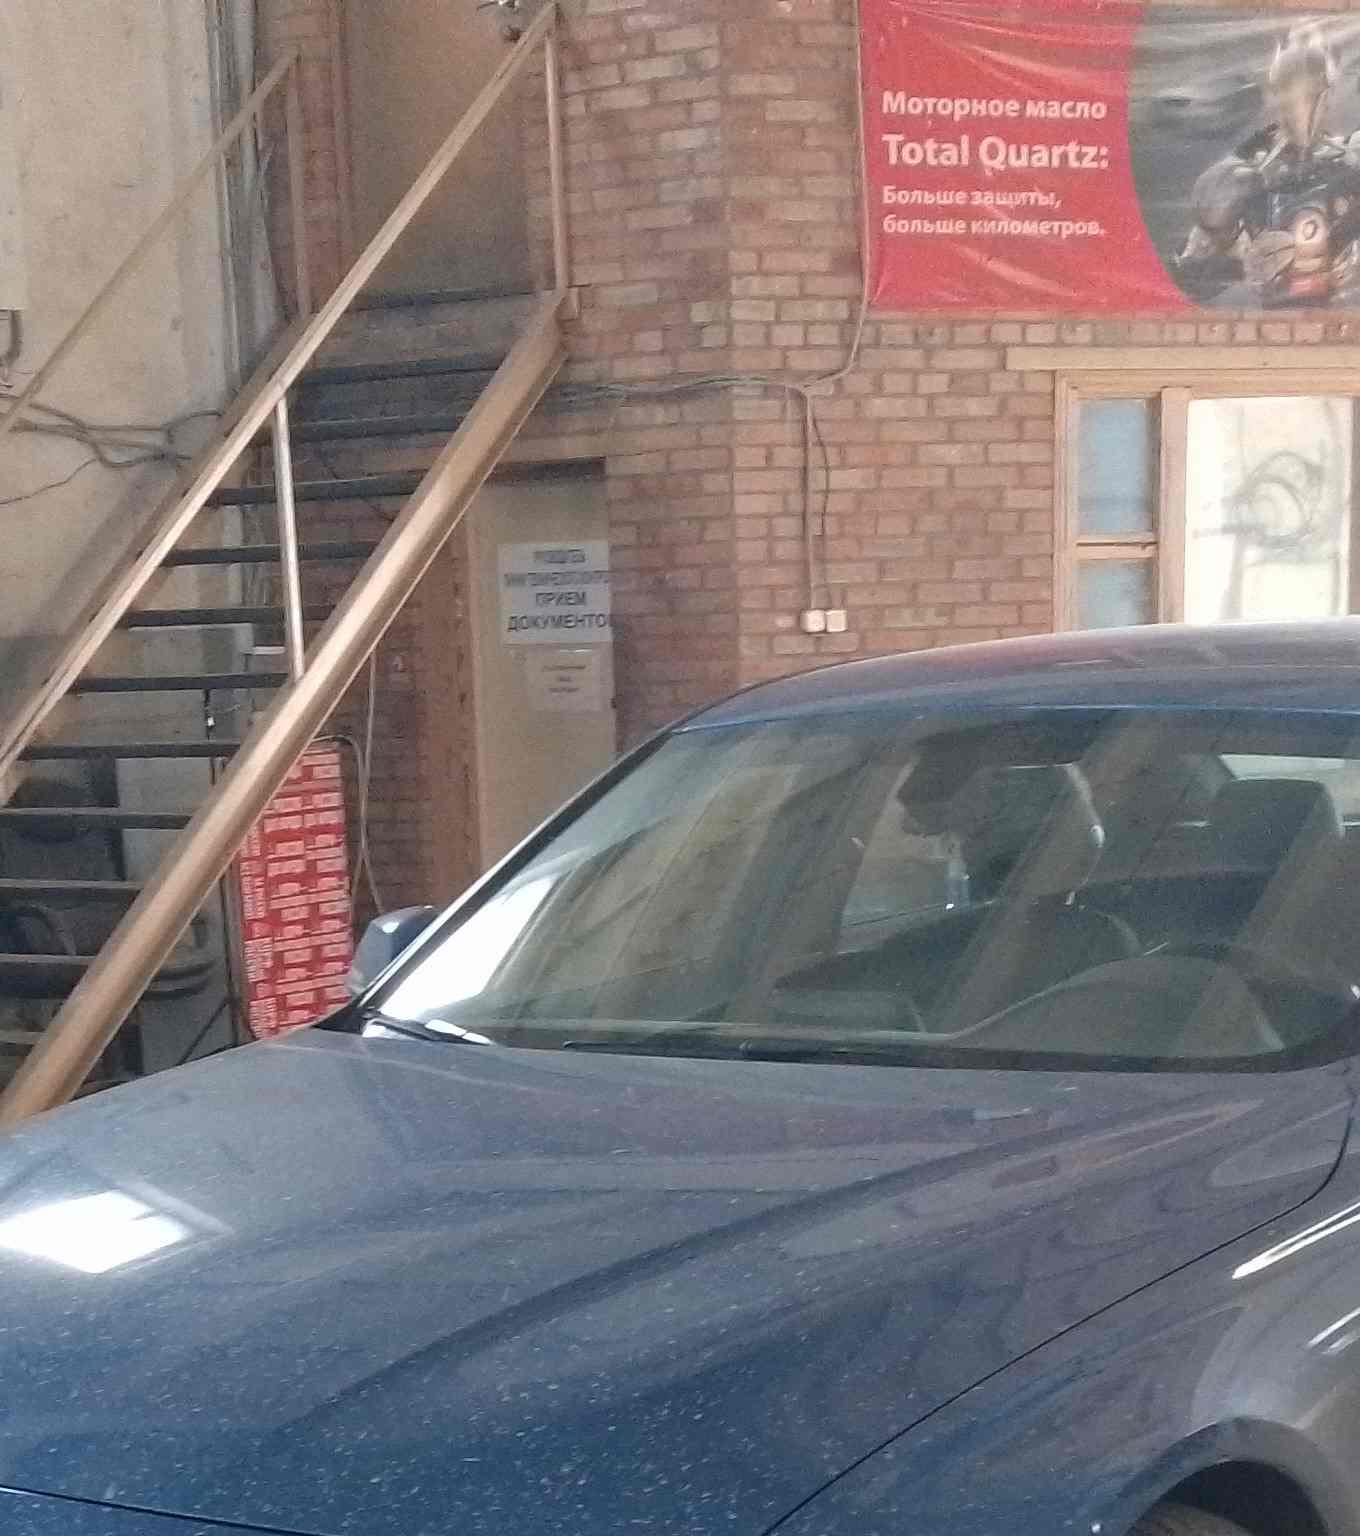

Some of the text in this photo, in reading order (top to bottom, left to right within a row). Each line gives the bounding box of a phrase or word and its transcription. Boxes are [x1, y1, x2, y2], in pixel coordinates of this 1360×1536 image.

[882, 90, 1108, 121] Моторное масло
[882, 134, 1109, 171] Total Quartz:
[883, 185, 1062, 209] Больше защиты,
[883, 214, 1105, 239] больше километров.
[507, 613, 608, 632] ДОКУМЕНТО
